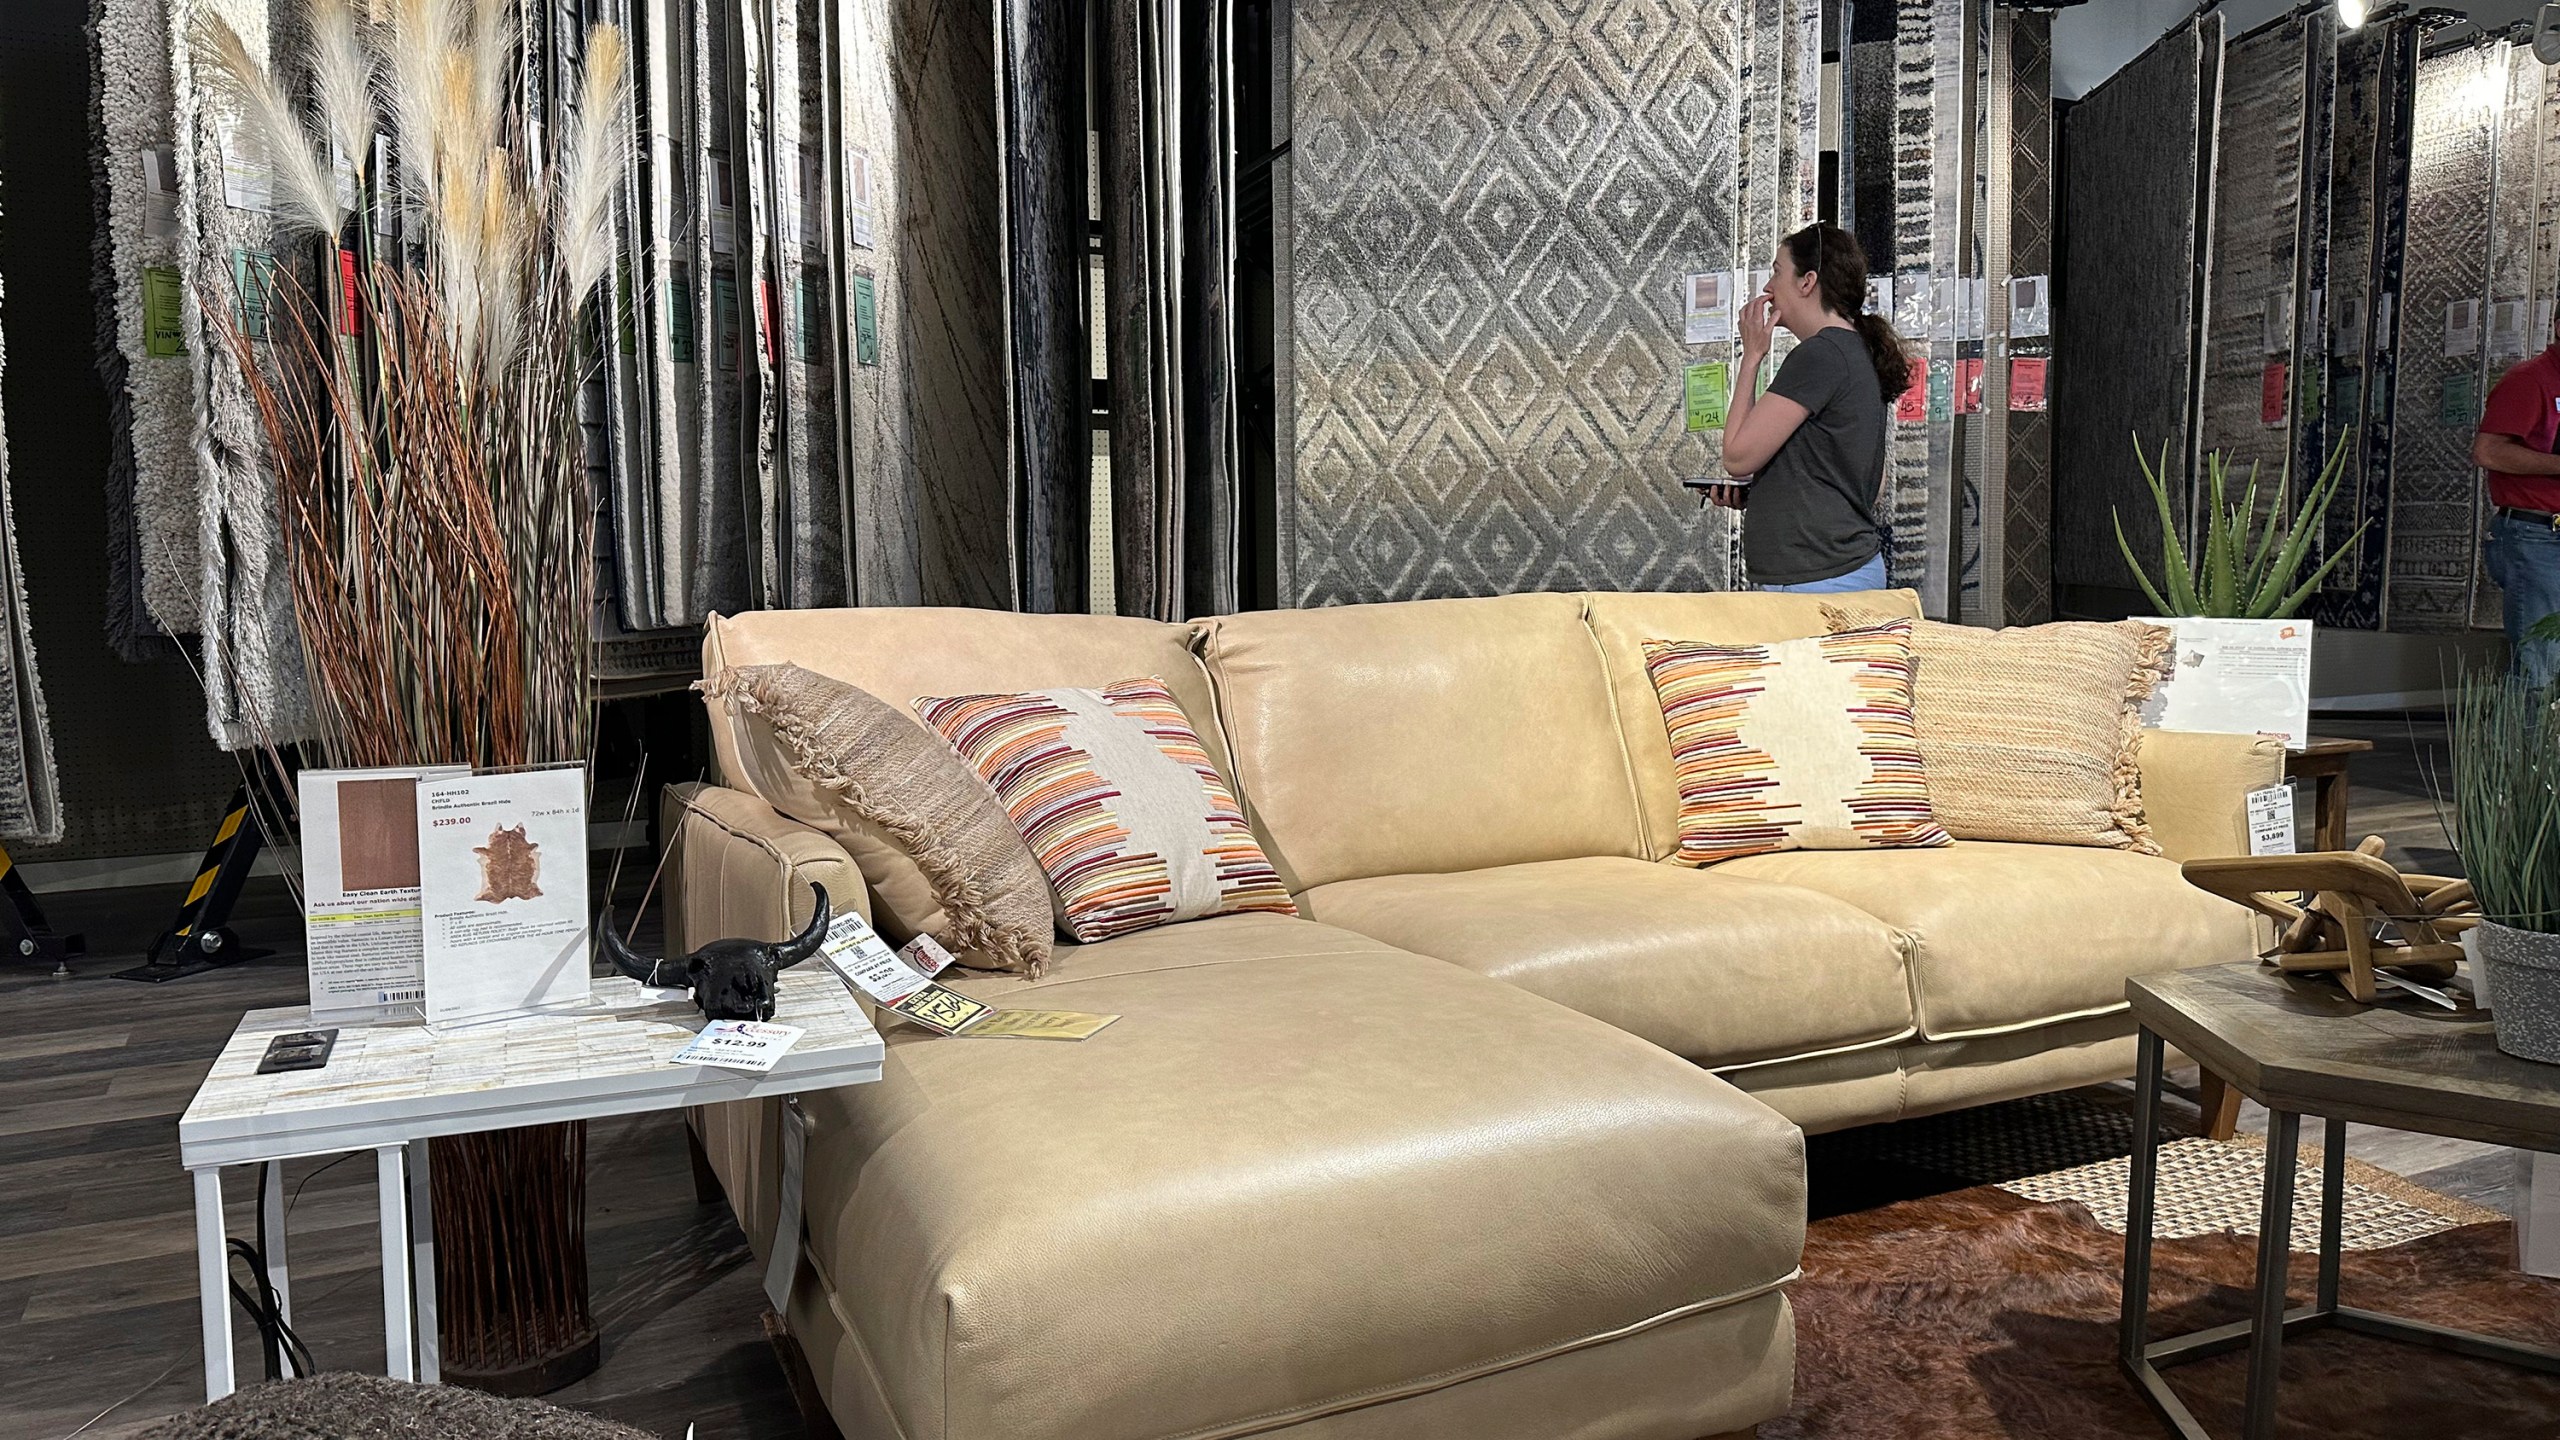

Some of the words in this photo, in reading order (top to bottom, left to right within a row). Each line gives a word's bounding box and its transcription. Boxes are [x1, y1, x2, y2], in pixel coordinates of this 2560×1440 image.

[1701, 411, 1720, 424] 124
[432, 816, 471, 827] $239.00
[908, 991, 929, 1005] EXTRA
[712, 1038, 767, 1048] $12.99
